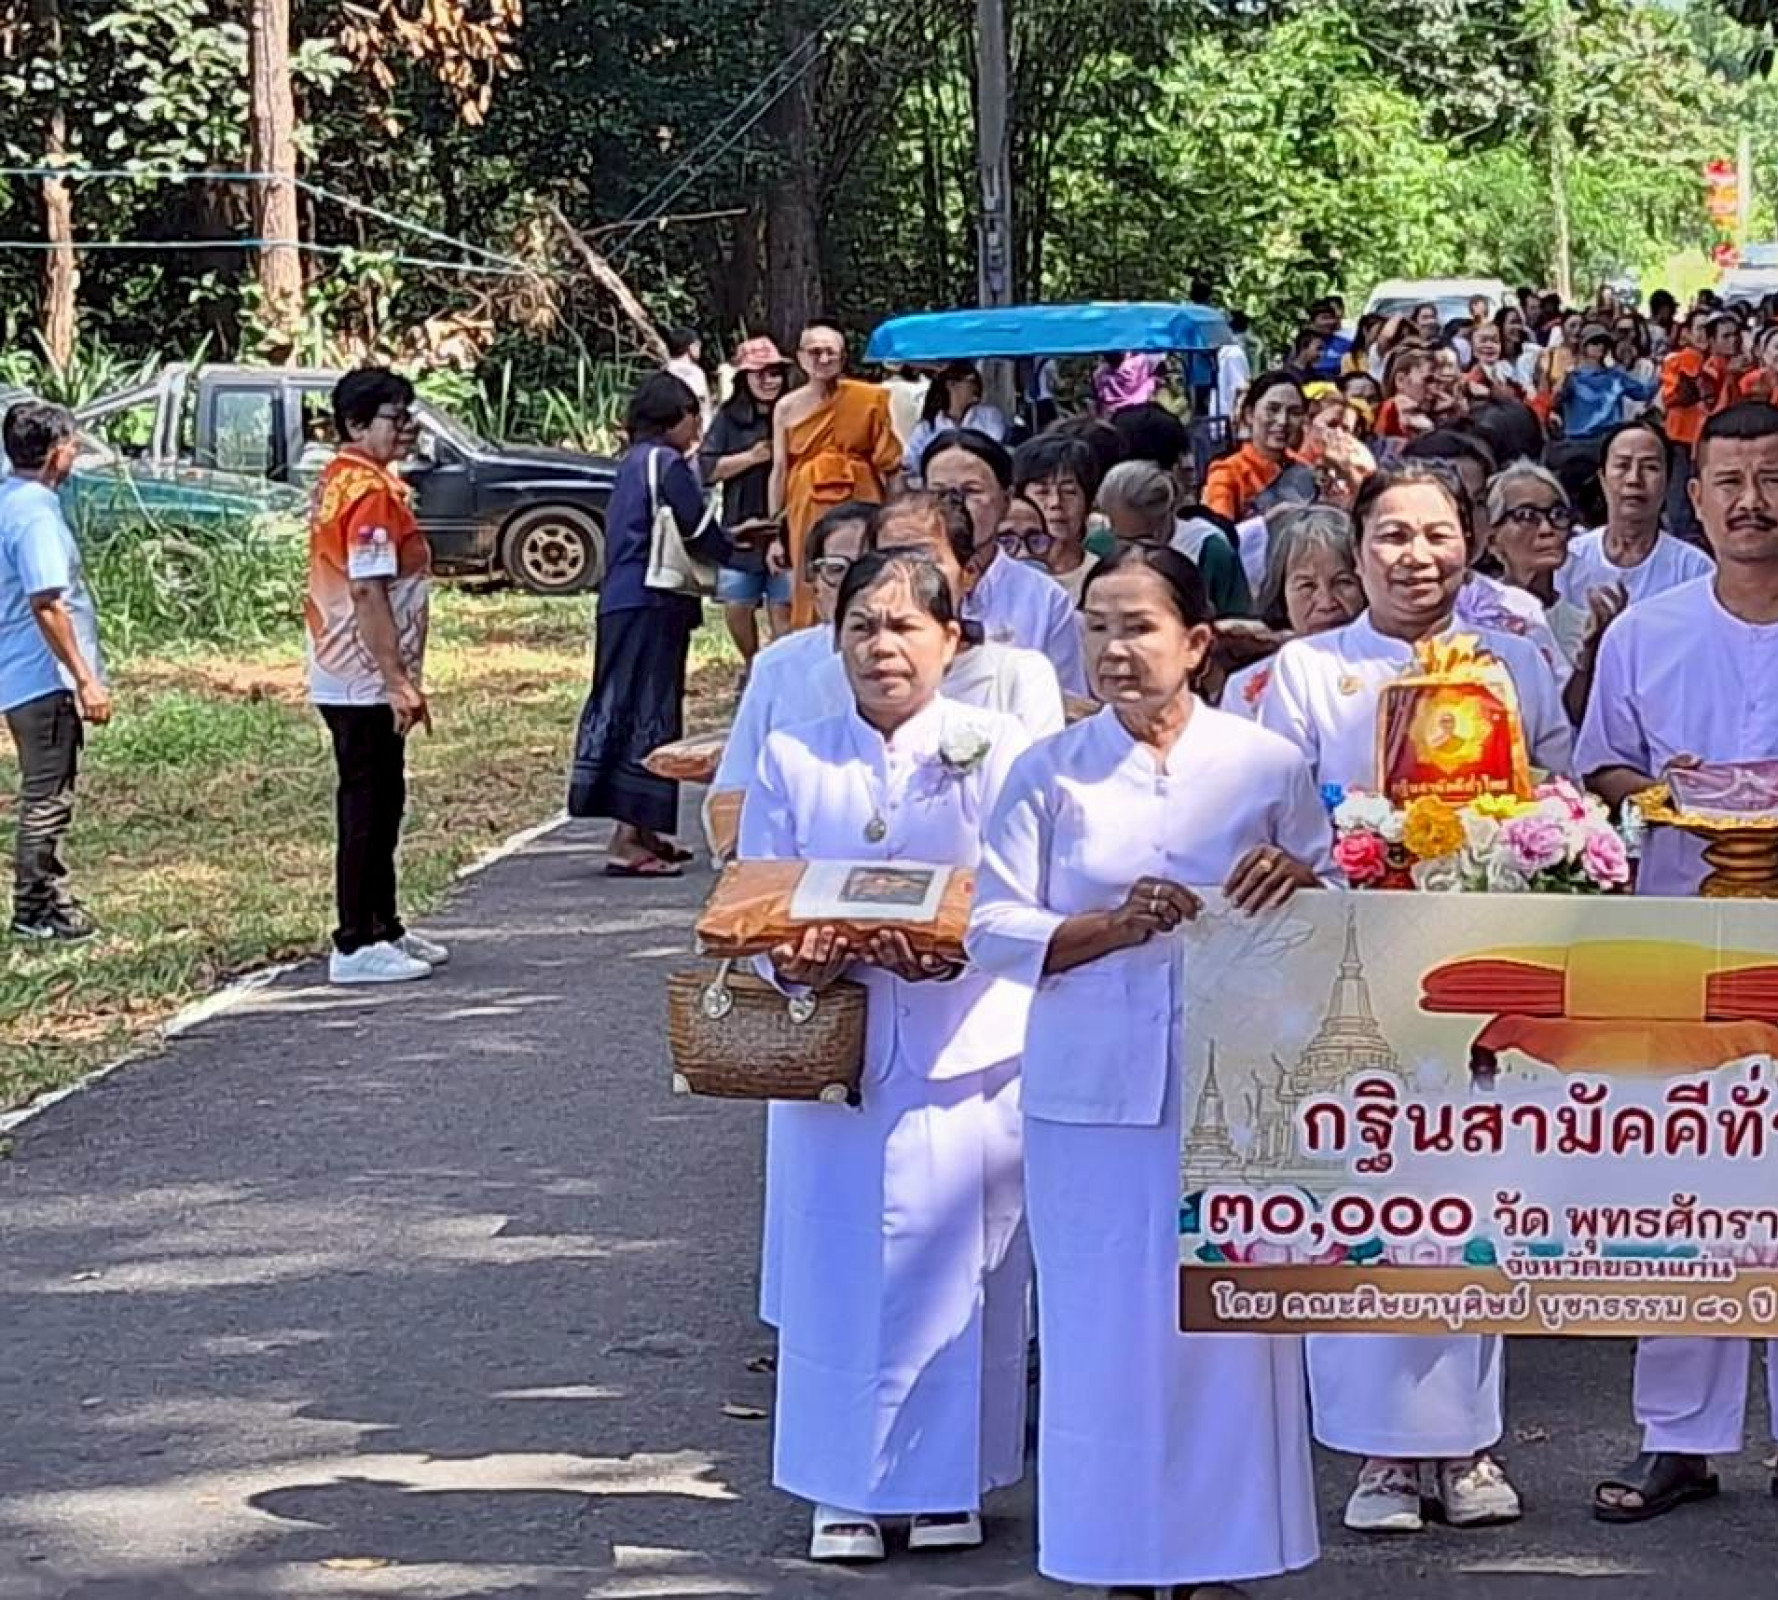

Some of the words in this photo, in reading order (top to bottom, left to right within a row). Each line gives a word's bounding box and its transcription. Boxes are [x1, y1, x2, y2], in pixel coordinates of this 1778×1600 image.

[1208, 1193, 1473, 1246] ๓๐,๐๐๐
[1494, 1191, 1549, 1238] วัด
[1505, 1251, 1733, 1279] จังหวัดขอนแก่น
[1214, 1284, 1275, 1317] โดย
[1285, 1284, 1530, 1328] คณะศิษยานุศิษย์
[1539, 1294, 1685, 1327] บูชาธรรม
[1693, 1297, 1739, 1320] ๘๑
[1750, 1286, 1776, 1321] ปี
